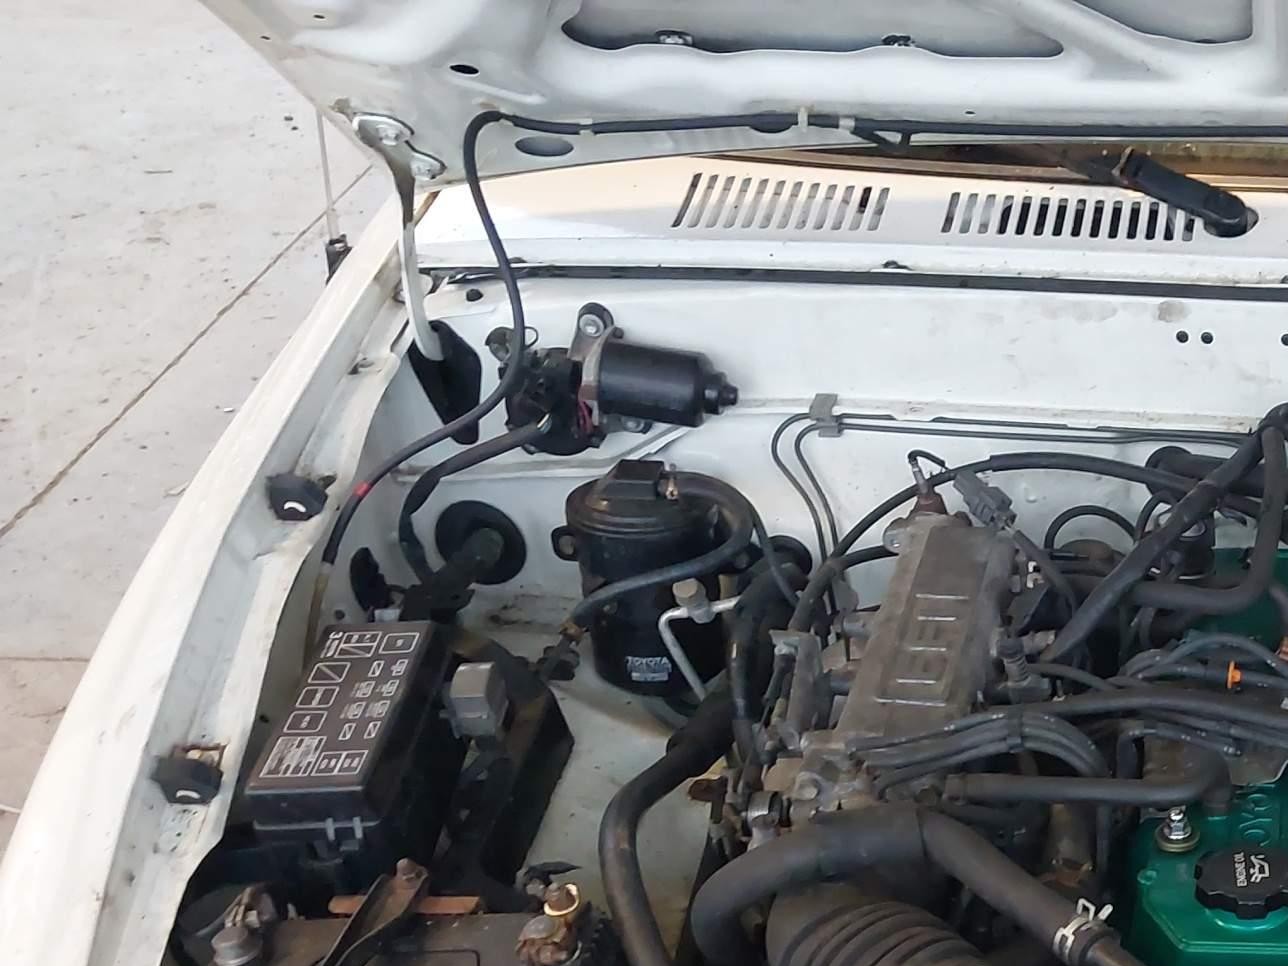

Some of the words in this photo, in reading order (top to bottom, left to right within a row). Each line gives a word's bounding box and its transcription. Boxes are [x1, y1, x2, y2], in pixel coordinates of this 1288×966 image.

[624, 656, 670, 666] TOYOTA
[1233, 852, 1245, 862] OIL
[1235, 862, 1248, 887] ENGINE
